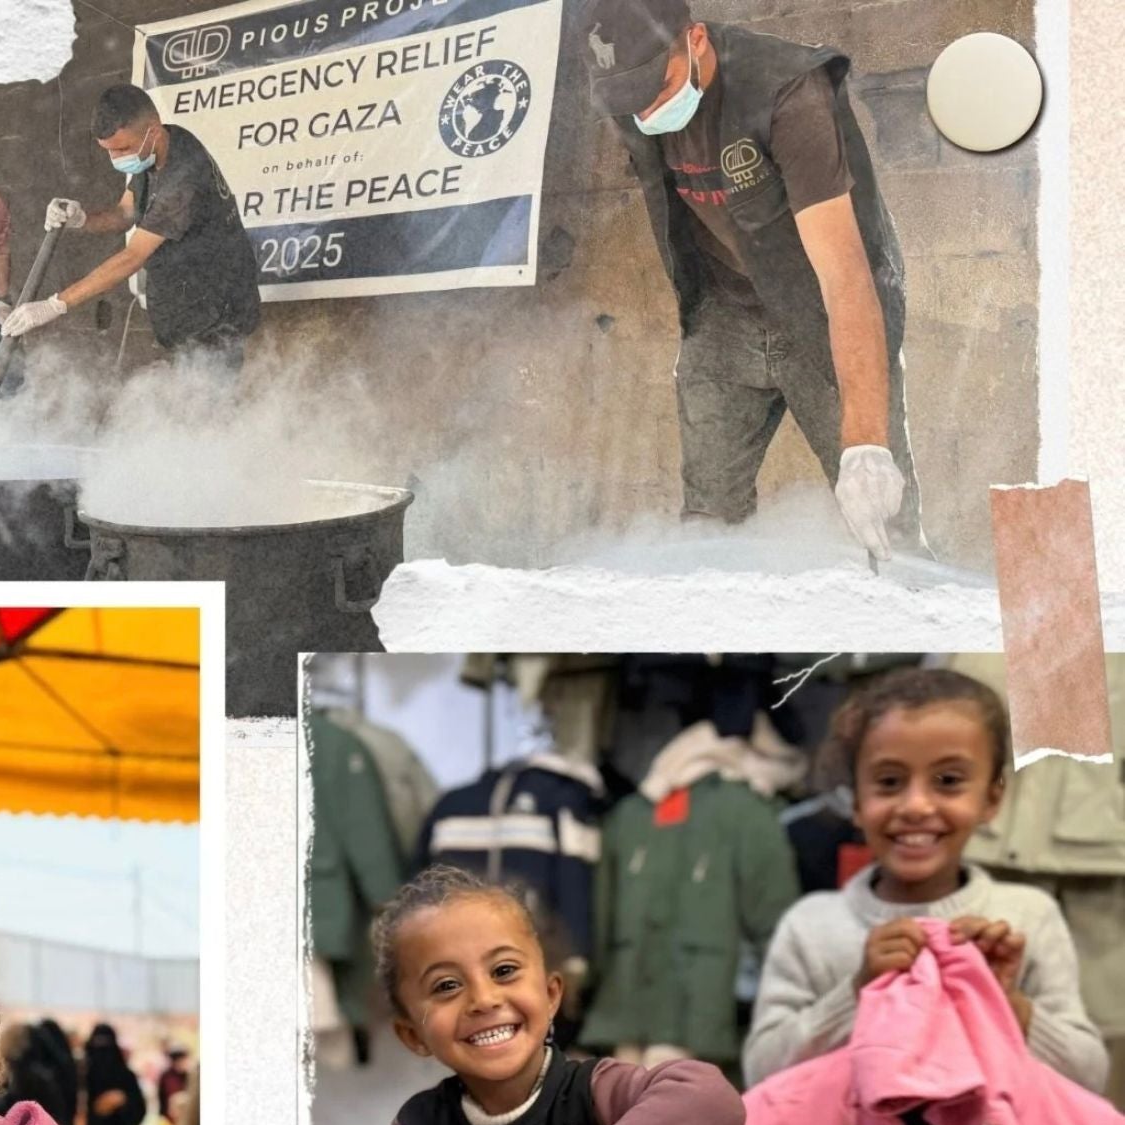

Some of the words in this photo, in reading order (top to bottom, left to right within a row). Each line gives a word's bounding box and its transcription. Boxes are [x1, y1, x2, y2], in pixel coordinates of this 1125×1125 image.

[241, 14, 329, 50] PIOUS
[174, 55, 366, 114] EMERGENCY
[376, 26, 498, 79] RELIEF
[444, 65, 485, 109] WEAR
[501, 63, 528, 92] THE
[237, 118, 299, 150] FOR
[309, 99, 402, 139] GAZA
[451, 124, 514, 157] PEACE
[262, 163, 279, 175] on
[286, 153, 338, 172] behalf
[343, 151, 365, 165] of:
[273, 183, 334, 215] THE
[345, 165, 463, 207] PEACE
[260, 232, 345, 273] 2025
